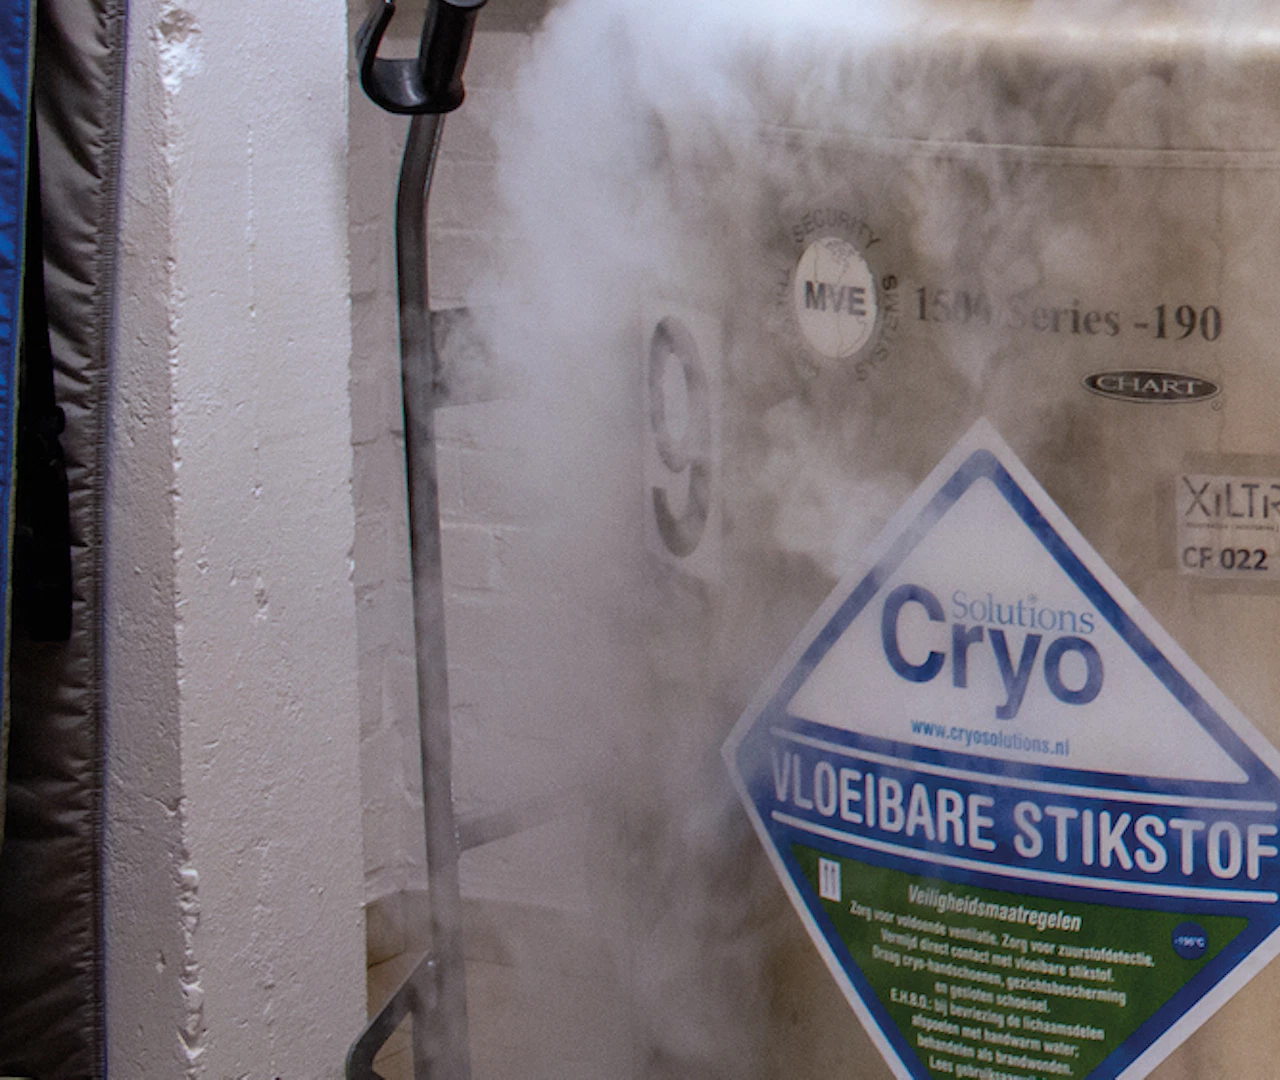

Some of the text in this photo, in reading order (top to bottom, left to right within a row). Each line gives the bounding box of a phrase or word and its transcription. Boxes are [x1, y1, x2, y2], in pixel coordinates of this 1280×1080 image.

[804, 280, 867, 316] MVE
[1007, 292, 1121, 337] Series
[1097, 376, 1202, 395] CHART
[1182, 546, 1268, 571] CF 022
[952, 590, 1095, 634] Solutions
[881, 583, 1104, 720] Cryo
[911, 719, 1070, 757] www.cryosolutions.nl
[772, 750, 1279, 880] VLOEIBARE STIKSTOF
[850, 899, 873, 922] Zorg
[1002, 933, 1028, 953] Zorg
[1030, 939, 1055, 955] voor
[908, 883, 1082, 932] Veiligheidsmaatregelen
[919, 936, 949, 956] direct
